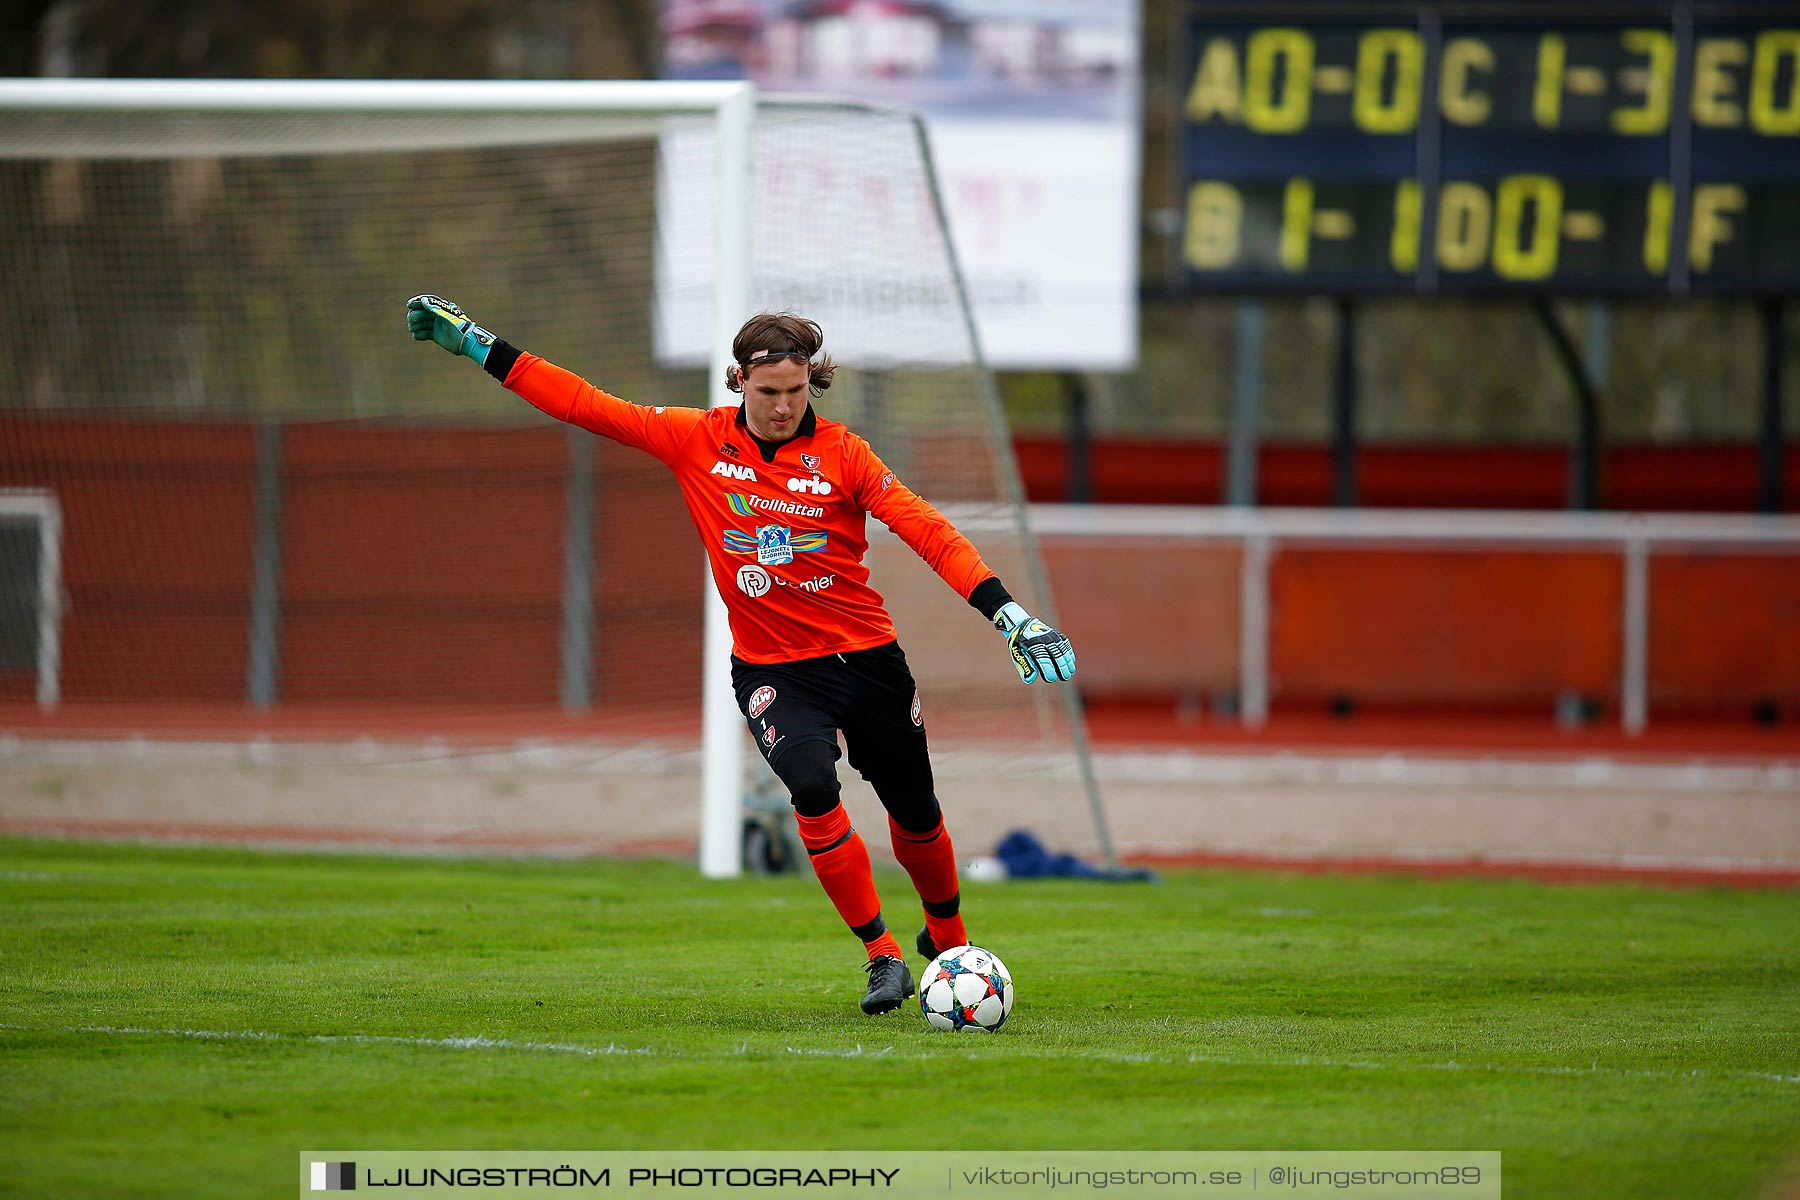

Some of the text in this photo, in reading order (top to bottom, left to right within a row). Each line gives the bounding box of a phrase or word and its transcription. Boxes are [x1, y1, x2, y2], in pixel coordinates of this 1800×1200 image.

[1185, 38, 1242, 124] A
[1439, 39, 1494, 124] C
[1692, 39, 1747, 126] E
[1185, 182, 1243, 270] B
[1437, 182, 1492, 270] D
[1689, 184, 1745, 272] F
[711, 461, 758, 482] ANA
[748, 494, 824, 518] Trollhättan
[787, 475, 832, 495] orio
[760, 717, 767, 731] 1
